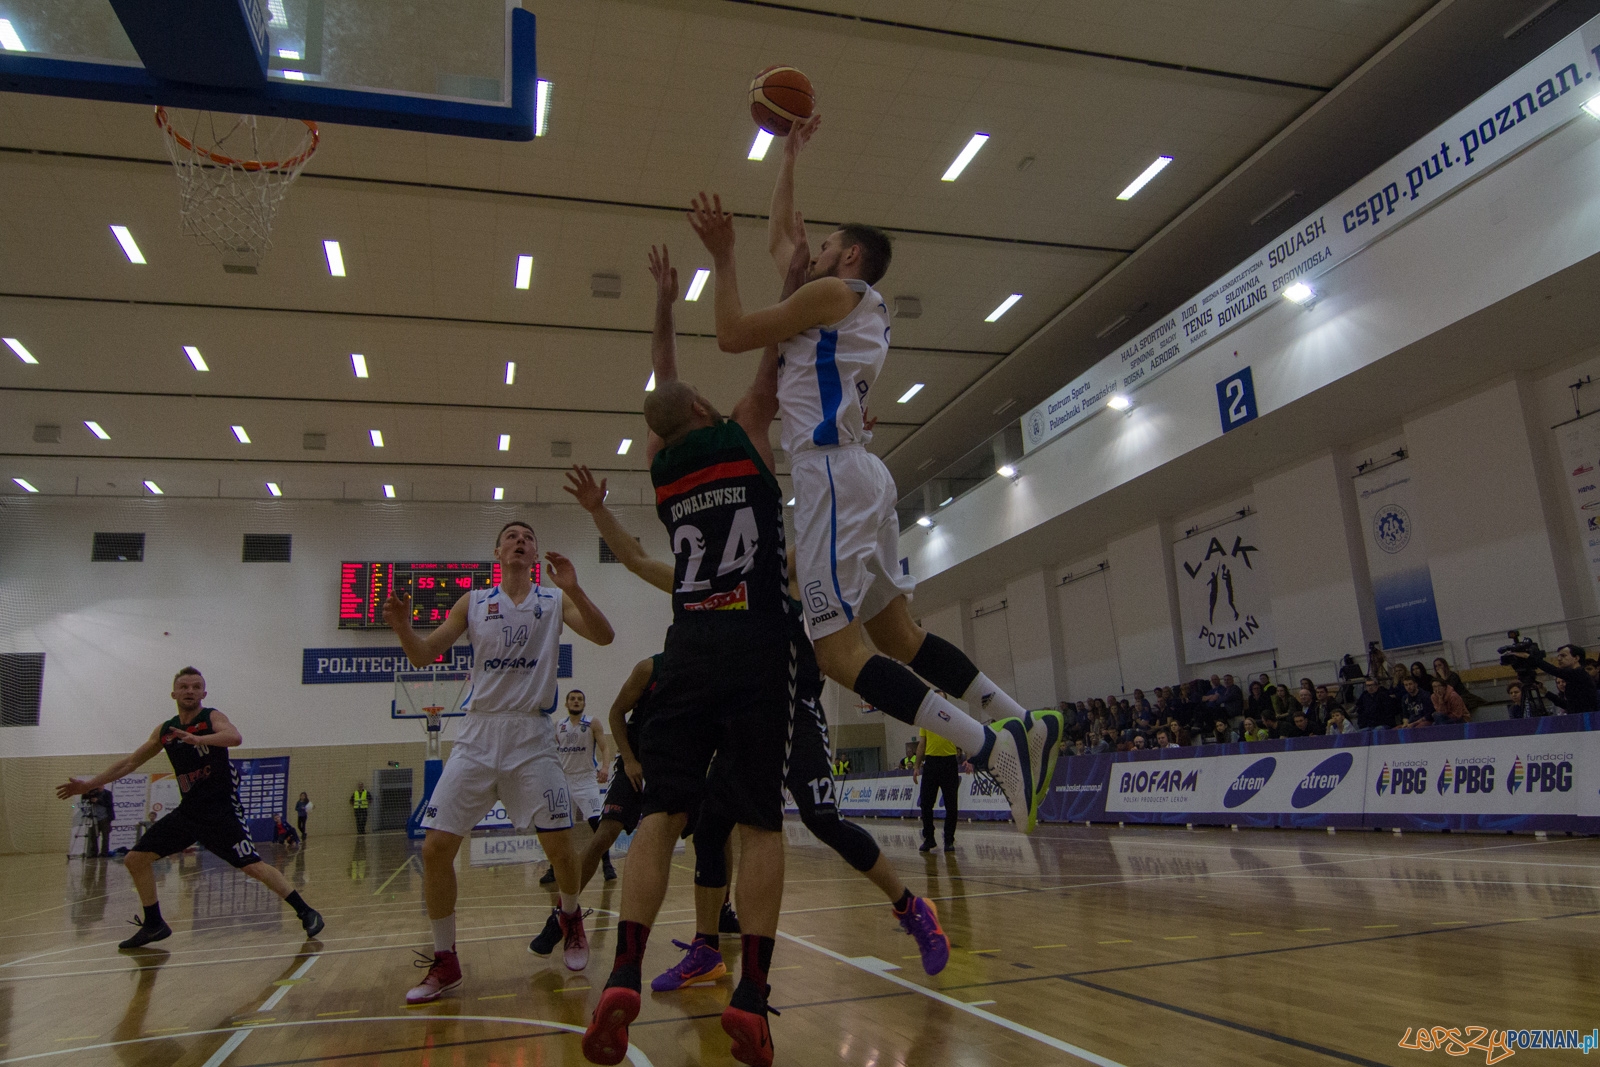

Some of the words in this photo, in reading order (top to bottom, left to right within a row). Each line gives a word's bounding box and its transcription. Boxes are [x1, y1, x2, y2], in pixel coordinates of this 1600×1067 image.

[1268, 216, 1326, 269] SQUASH
[1272, 246, 1332, 293] ERGOWIOSŁA
[1225, 275, 1260, 305] SIŁOWNIA
[1181, 303, 1198, 322] JUDO
[1217, 284, 1268, 327] BOWLING
[1183, 308, 1213, 337] TENIS
[1121, 344, 1139, 363] HALA
[1140, 318, 1177, 350] SPORTOWA
[1150, 343, 1180, 371] AEROBIK
[1123, 367, 1145, 388] BOISKA
[1047, 396, 1072, 415] Centrum
[1071, 380, 1091, 400] Sportu
[1225, 378, 1248, 424] 2
[1049, 405, 1081, 431] Politechniki
[670, 486, 747, 523] KOWALEWSKI
[673, 506, 760, 594] 24
[418, 577, 435, 589] 55
[455, 577, 472, 588] 48
[804, 580, 829, 613] 6
[502, 625, 528, 647] 14
[1198, 615, 1260, 650] POZNAŃ
[1392, 759, 1428, 767] fundacja
[1455, 756, 1496, 765] fundacja
[1526, 752, 1573, 762] fundacja
[807, 776, 835, 805] 12
[1120, 769, 1198, 793] BIOFARM
[1232, 774, 1265, 791] atrem
[1301, 771, 1340, 789] atrem
[1391, 767, 1427, 795] PBG
[1454, 764, 1495, 794] PBG
[1526, 761, 1573, 793] PBG
[543, 787, 568, 812] 14
[232, 839, 252, 858] 10
